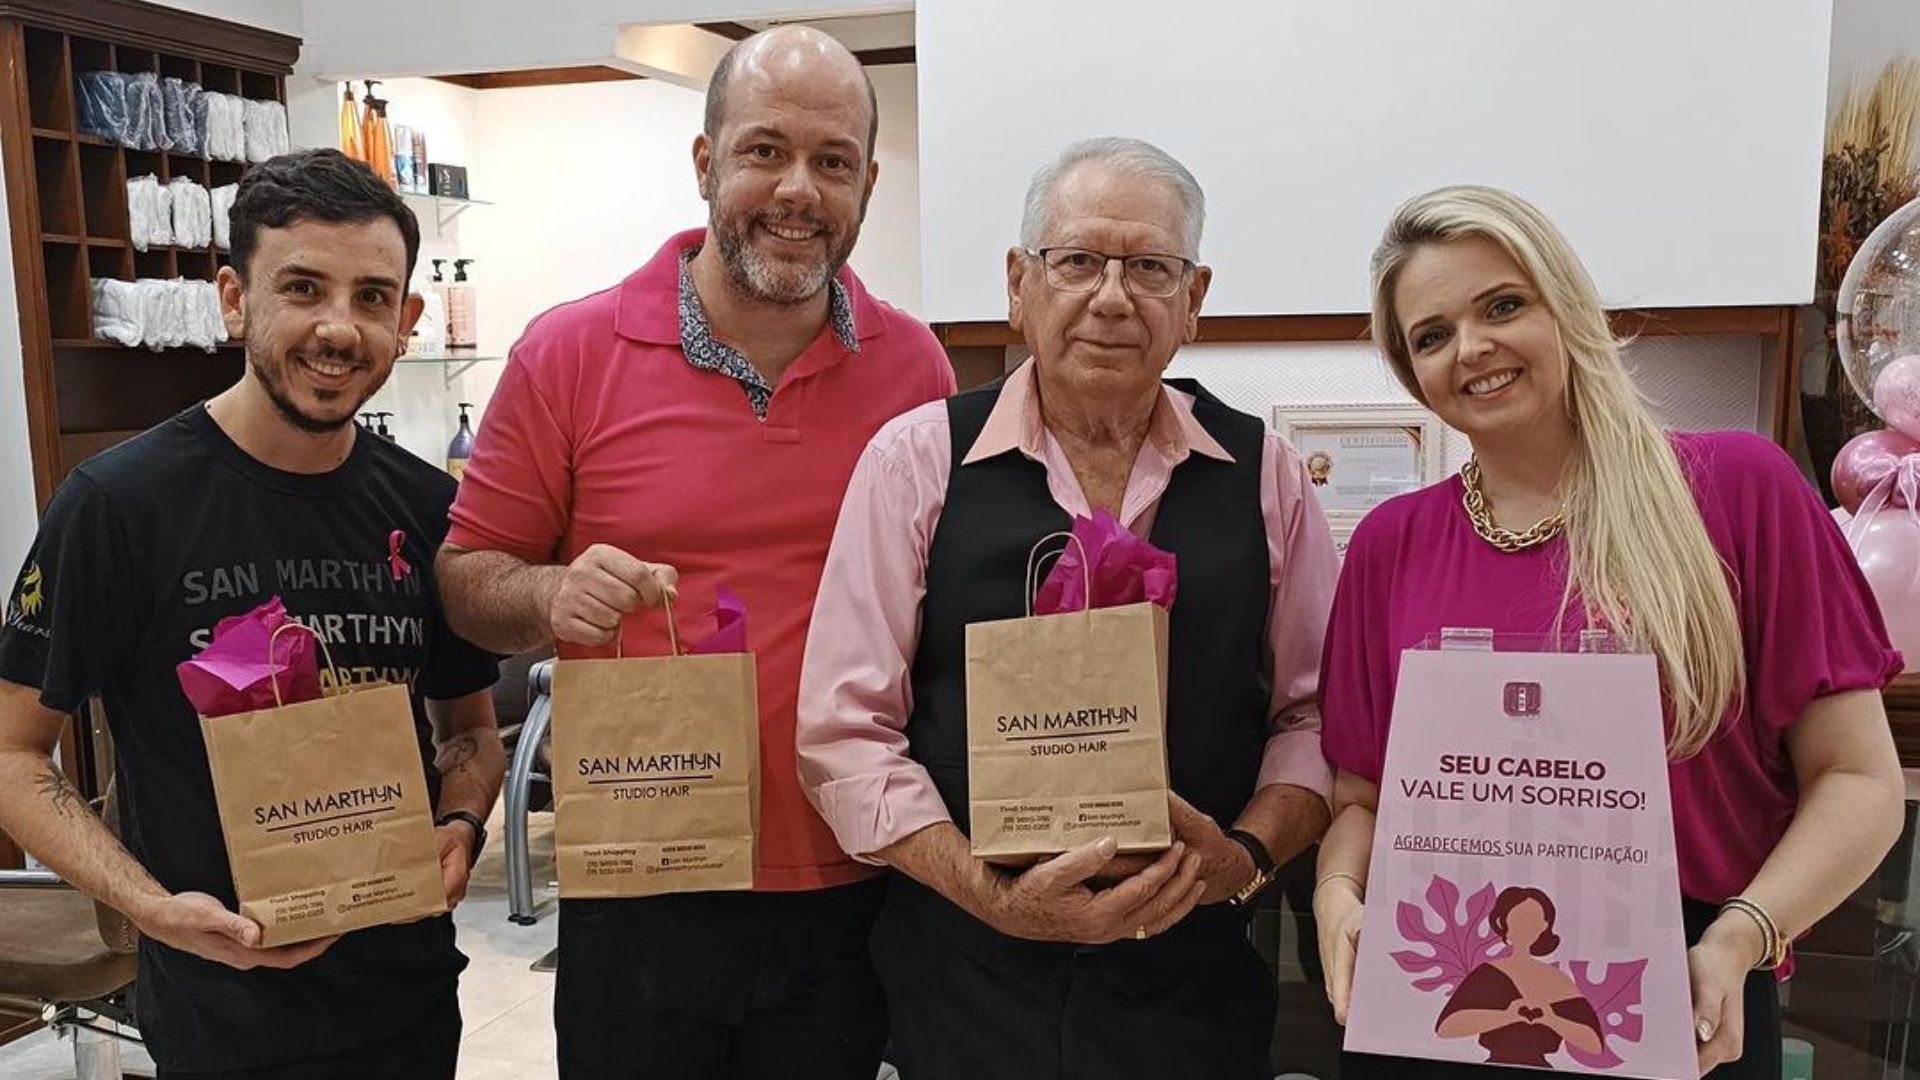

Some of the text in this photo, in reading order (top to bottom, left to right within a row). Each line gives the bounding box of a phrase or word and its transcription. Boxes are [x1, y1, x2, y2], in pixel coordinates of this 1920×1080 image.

[182, 562, 260, 605] SAN
[295, 613, 424, 646] ARTHYN
[996, 705, 1138, 733] SAN MARTHYN
[1030, 740, 1107, 756] STUDIO HAIR
[578, 752, 721, 776] SAN MARTHYN
[1439, 754, 1606, 780] SEU CABELO
[254, 782, 403, 826] SAN MARTHYN
[613, 785, 690, 801] STUDIO HAIR
[1400, 778, 1647, 811] VALE UM SORRISO!
[293, 819, 374, 844] STUDIO HAIR
[1394, 835, 1648, 865] AGRADECEMOS SUA PARTICIPAÇÃO!
